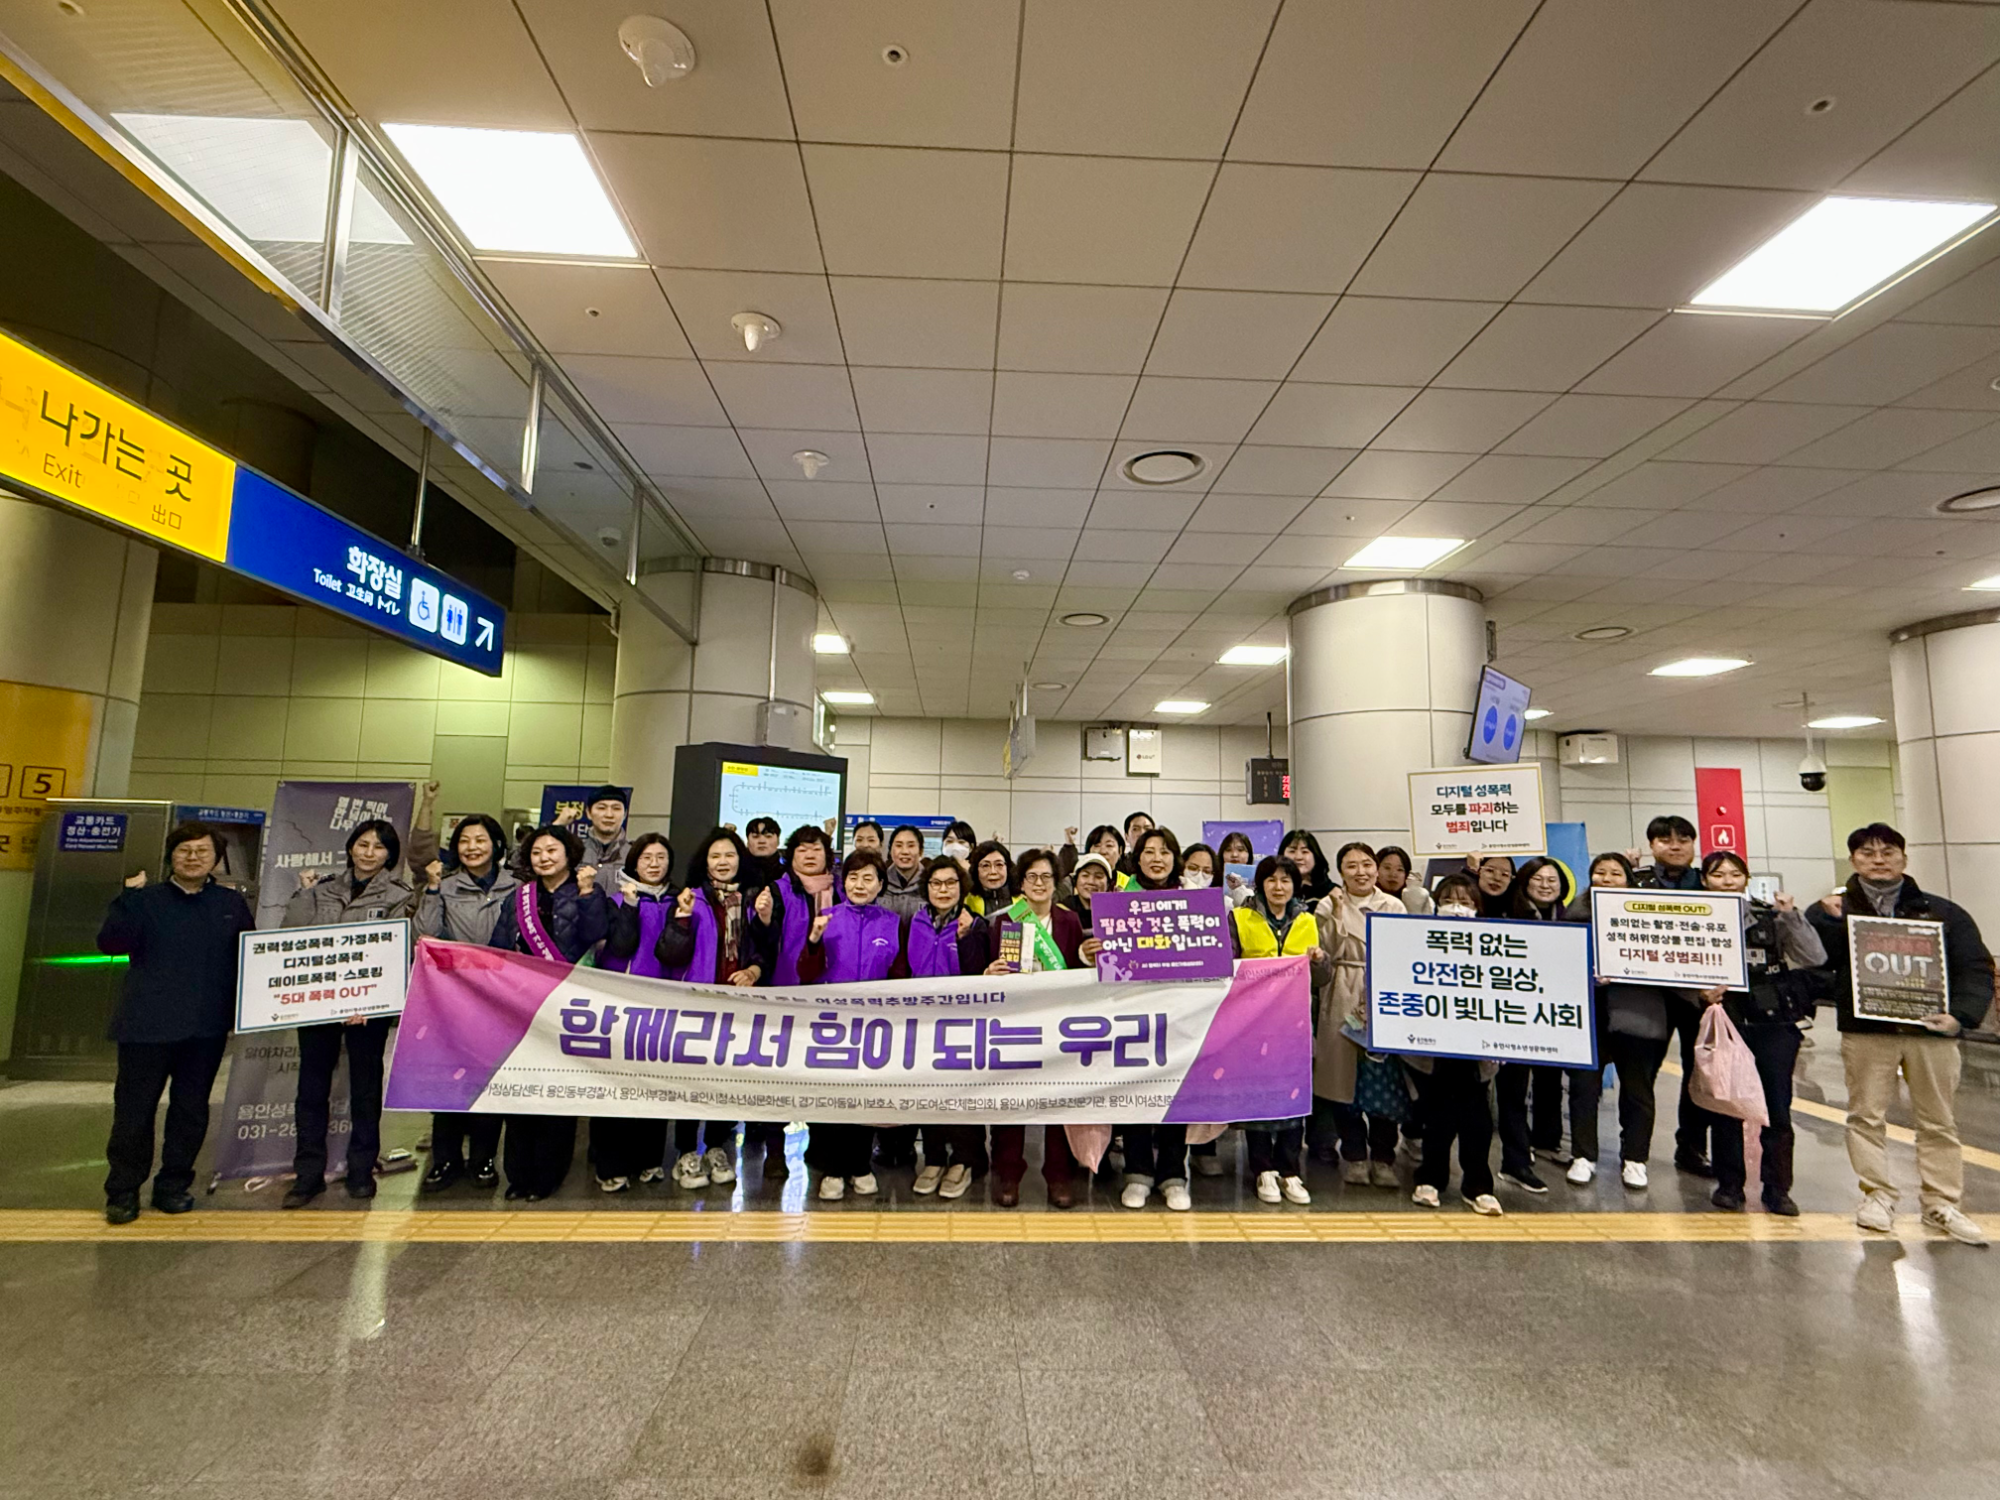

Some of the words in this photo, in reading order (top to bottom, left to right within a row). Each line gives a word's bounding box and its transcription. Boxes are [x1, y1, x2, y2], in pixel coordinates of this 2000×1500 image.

[41, 390, 145, 481] 나가는
[165, 454, 192, 502] 곳
[43, 453, 83, 488] Exit
[152, 504, 182, 530] 出口
[313, 568, 342, 593] Toilet
[347, 546, 403, 600] 화장실
[346, 583, 374, 607] 卫生间
[377, 596, 400, 616] トイレ
[33, 774, 53, 794] 5
[1437, 785, 1473, 798] 디지털
[1475, 783, 1512, 797] 성폭력
[1431, 803, 1467, 815] 모두를
[1468, 802, 1519, 815] 파괴하는
[75, 815, 115, 825] 교통카드
[1446, 820, 1508, 833] 범죄입니다
[275, 851, 333, 868] 사랑해서
[1129, 899, 1188, 915] 우리에게
[1632, 903, 1656, 911] 디지털
[1099, 918, 1143, 935] 필요한
[1146, 916, 1174, 934] 것은
[1177, 914, 1221, 932] 폭력이
[1102, 936, 1133, 953] 아닌
[1136, 934, 1223, 951] 대화입니다.
[1426, 930, 1473, 955] 폭력
[1479, 932, 1528, 958] 없는
[1606, 932, 1627, 942] 성적
[1619, 948, 1659, 962] 디지털
[1662, 950, 1723, 966] 성범죄!!!
[1864, 952, 1933, 977] OUT
[1412, 961, 1484, 988] 안전한
[1489, 966, 1544, 994] 일상,
[308, 989, 336, 1002] 폭력
[1378, 990, 1448, 1019] 존중이
[1454, 996, 1527, 1025] 빛나는
[1533, 1002, 1583, 1030] 사회
[805, 1011, 918, 1070] 힘이
[932, 1017, 1043, 1070] 되는
[1058, 1013, 1167, 1068] 우리
